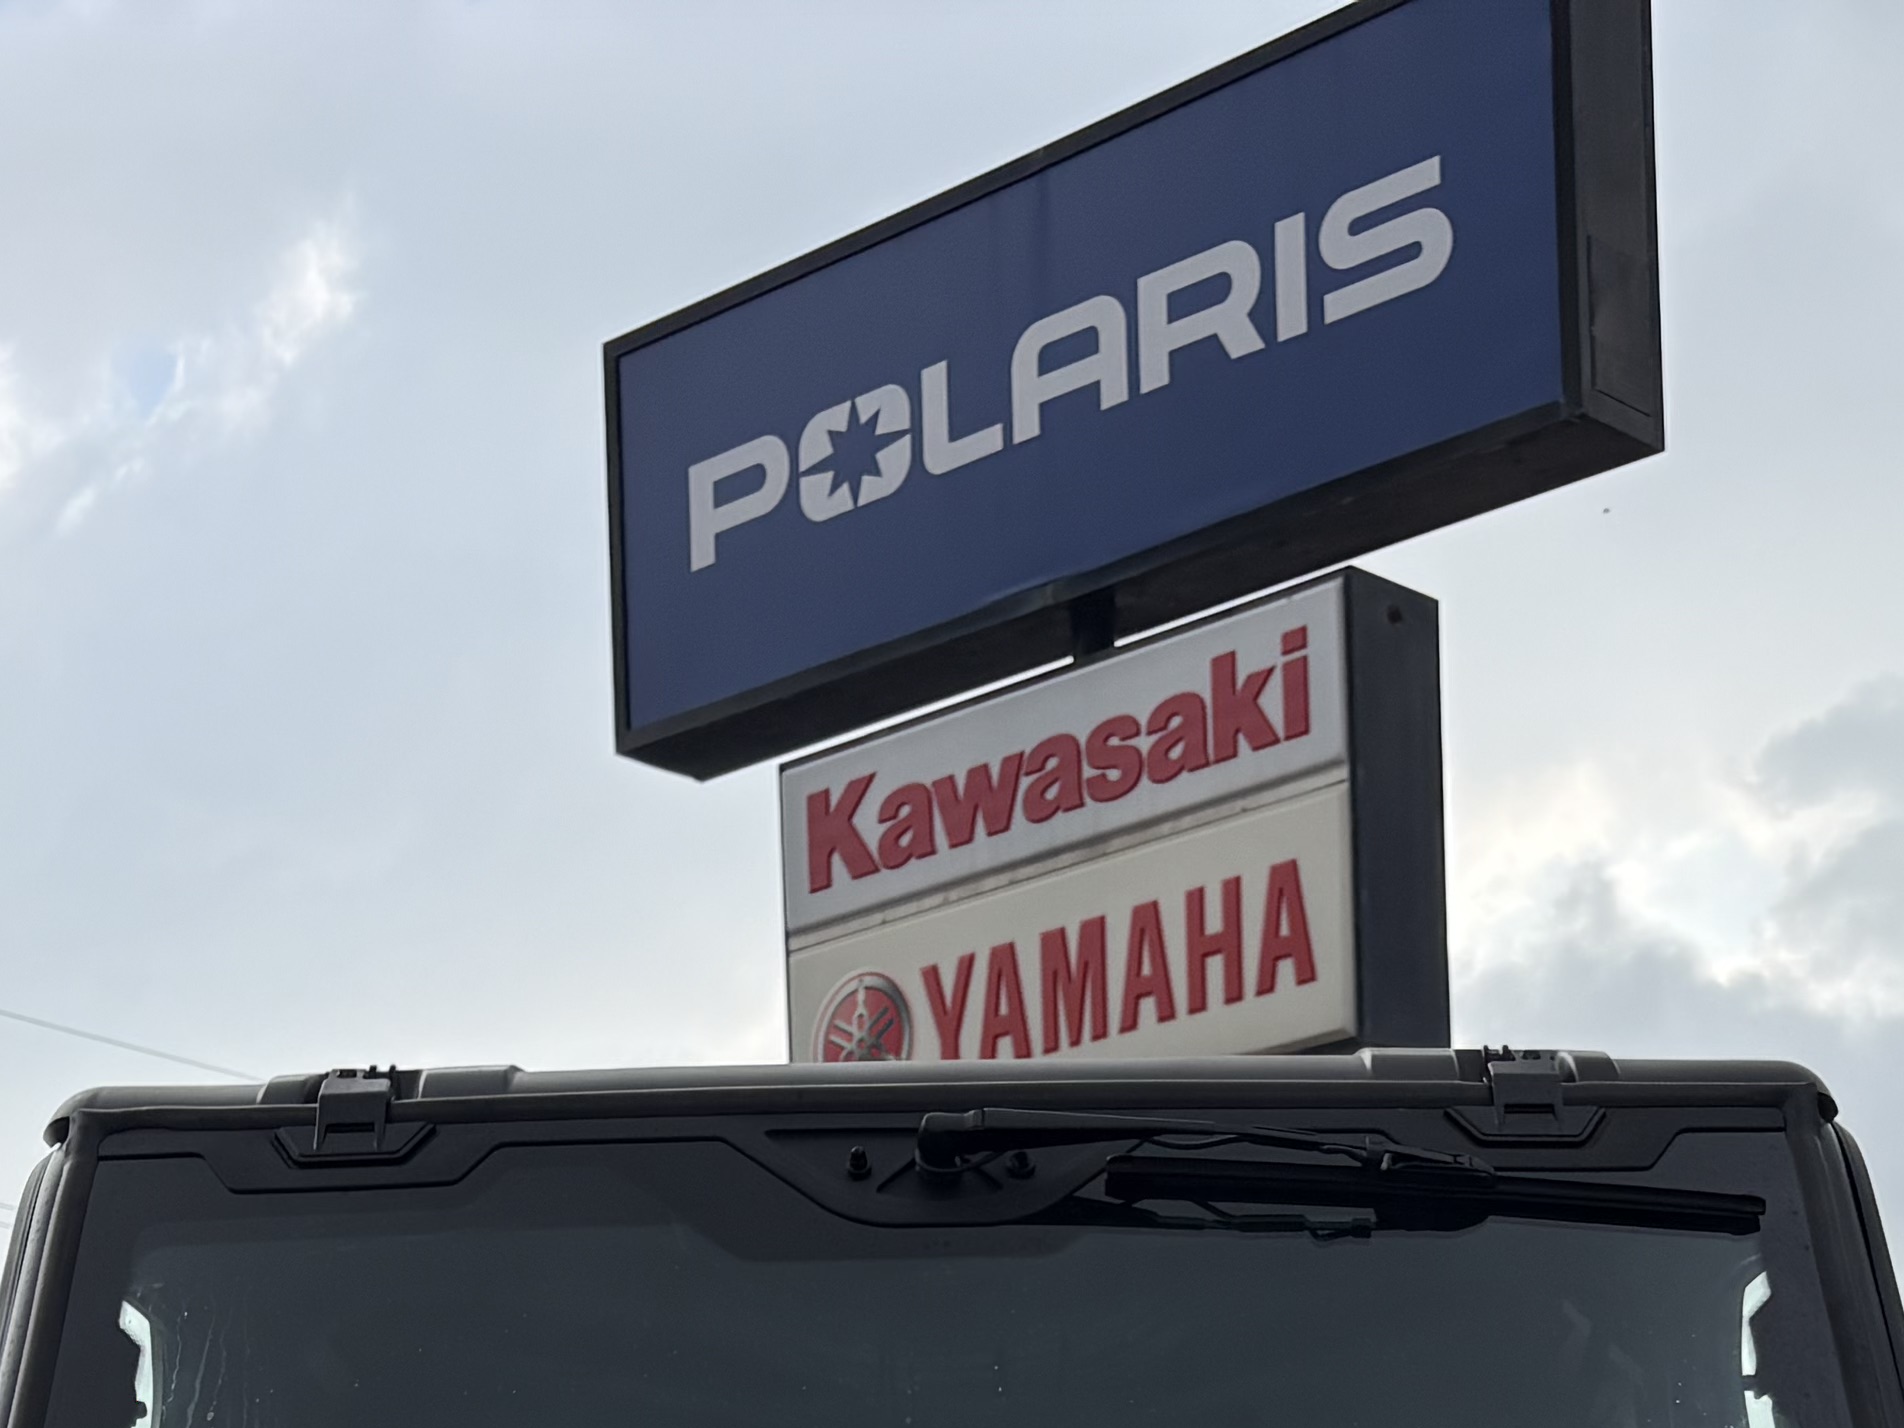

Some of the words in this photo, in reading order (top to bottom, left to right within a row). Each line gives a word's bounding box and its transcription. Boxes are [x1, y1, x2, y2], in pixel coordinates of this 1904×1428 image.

[687, 154, 1454, 572] POLARIS
[805, 624, 1311, 894] Kawasaki
[920, 857, 1318, 1061] YAMAHA
